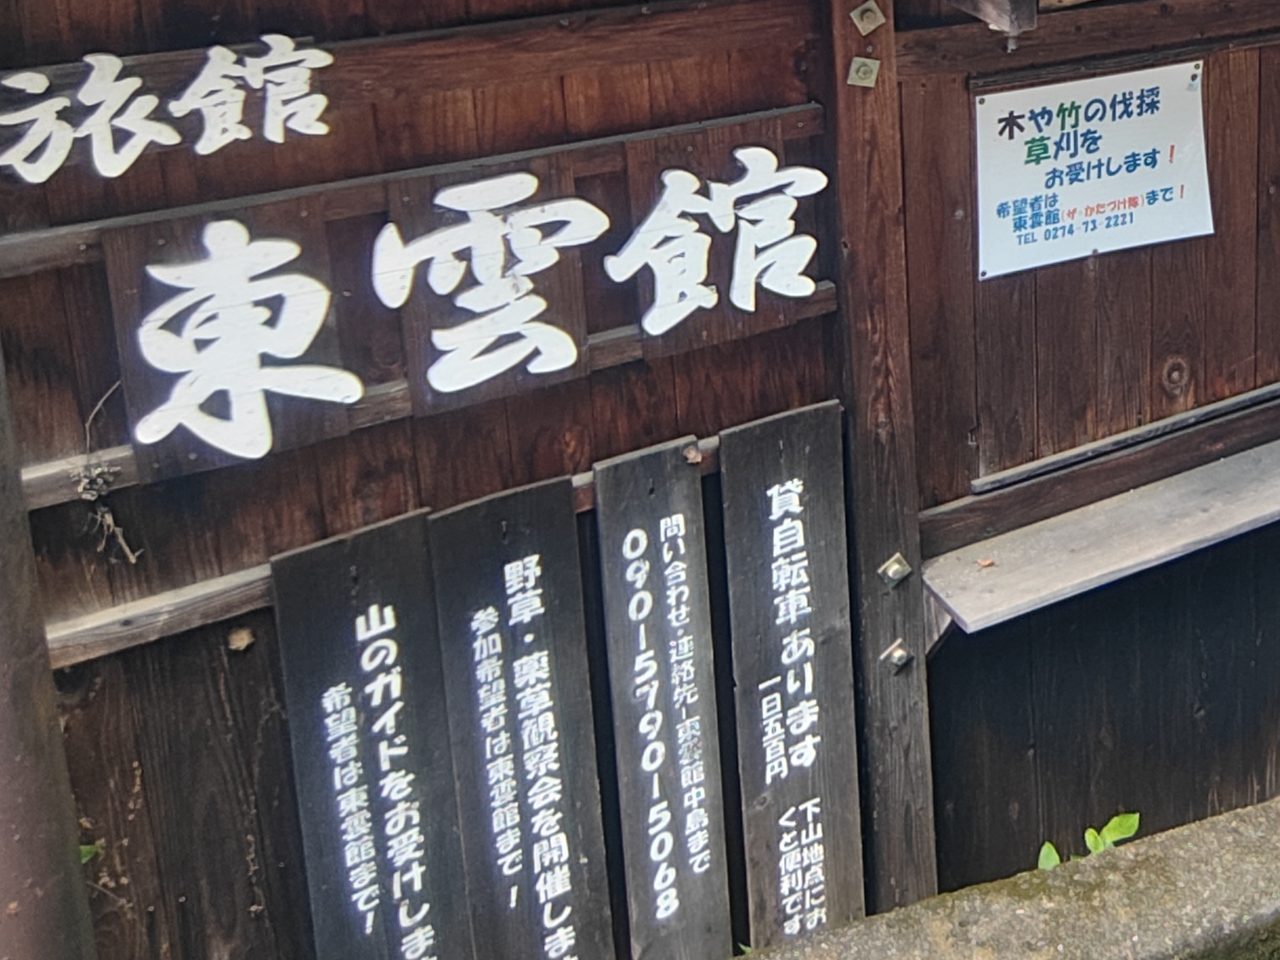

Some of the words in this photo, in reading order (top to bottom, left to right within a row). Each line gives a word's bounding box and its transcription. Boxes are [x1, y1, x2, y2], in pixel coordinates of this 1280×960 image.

[0, 34, 334, 184] 旅館
[997, 87, 1160, 140] 木や竹の伐採
[1024, 129, 1102, 165] 草刈を
[996, 193, 1059, 219] 希望者は
[1017, 233, 1038, 246] TEL
[135, 146, 829, 460] 東雲館
[766, 478, 822, 768] 貸自転車あります
[356, 604, 438, 960] 山のガイドをお受けしま
[504, 554, 579, 960] 野草・薬草観察会を開催しま
[758, 675, 789, 785] 一日五百円
[778, 806, 805, 935] くと便利です
[798, 797, 827, 923] 下山地点にお
